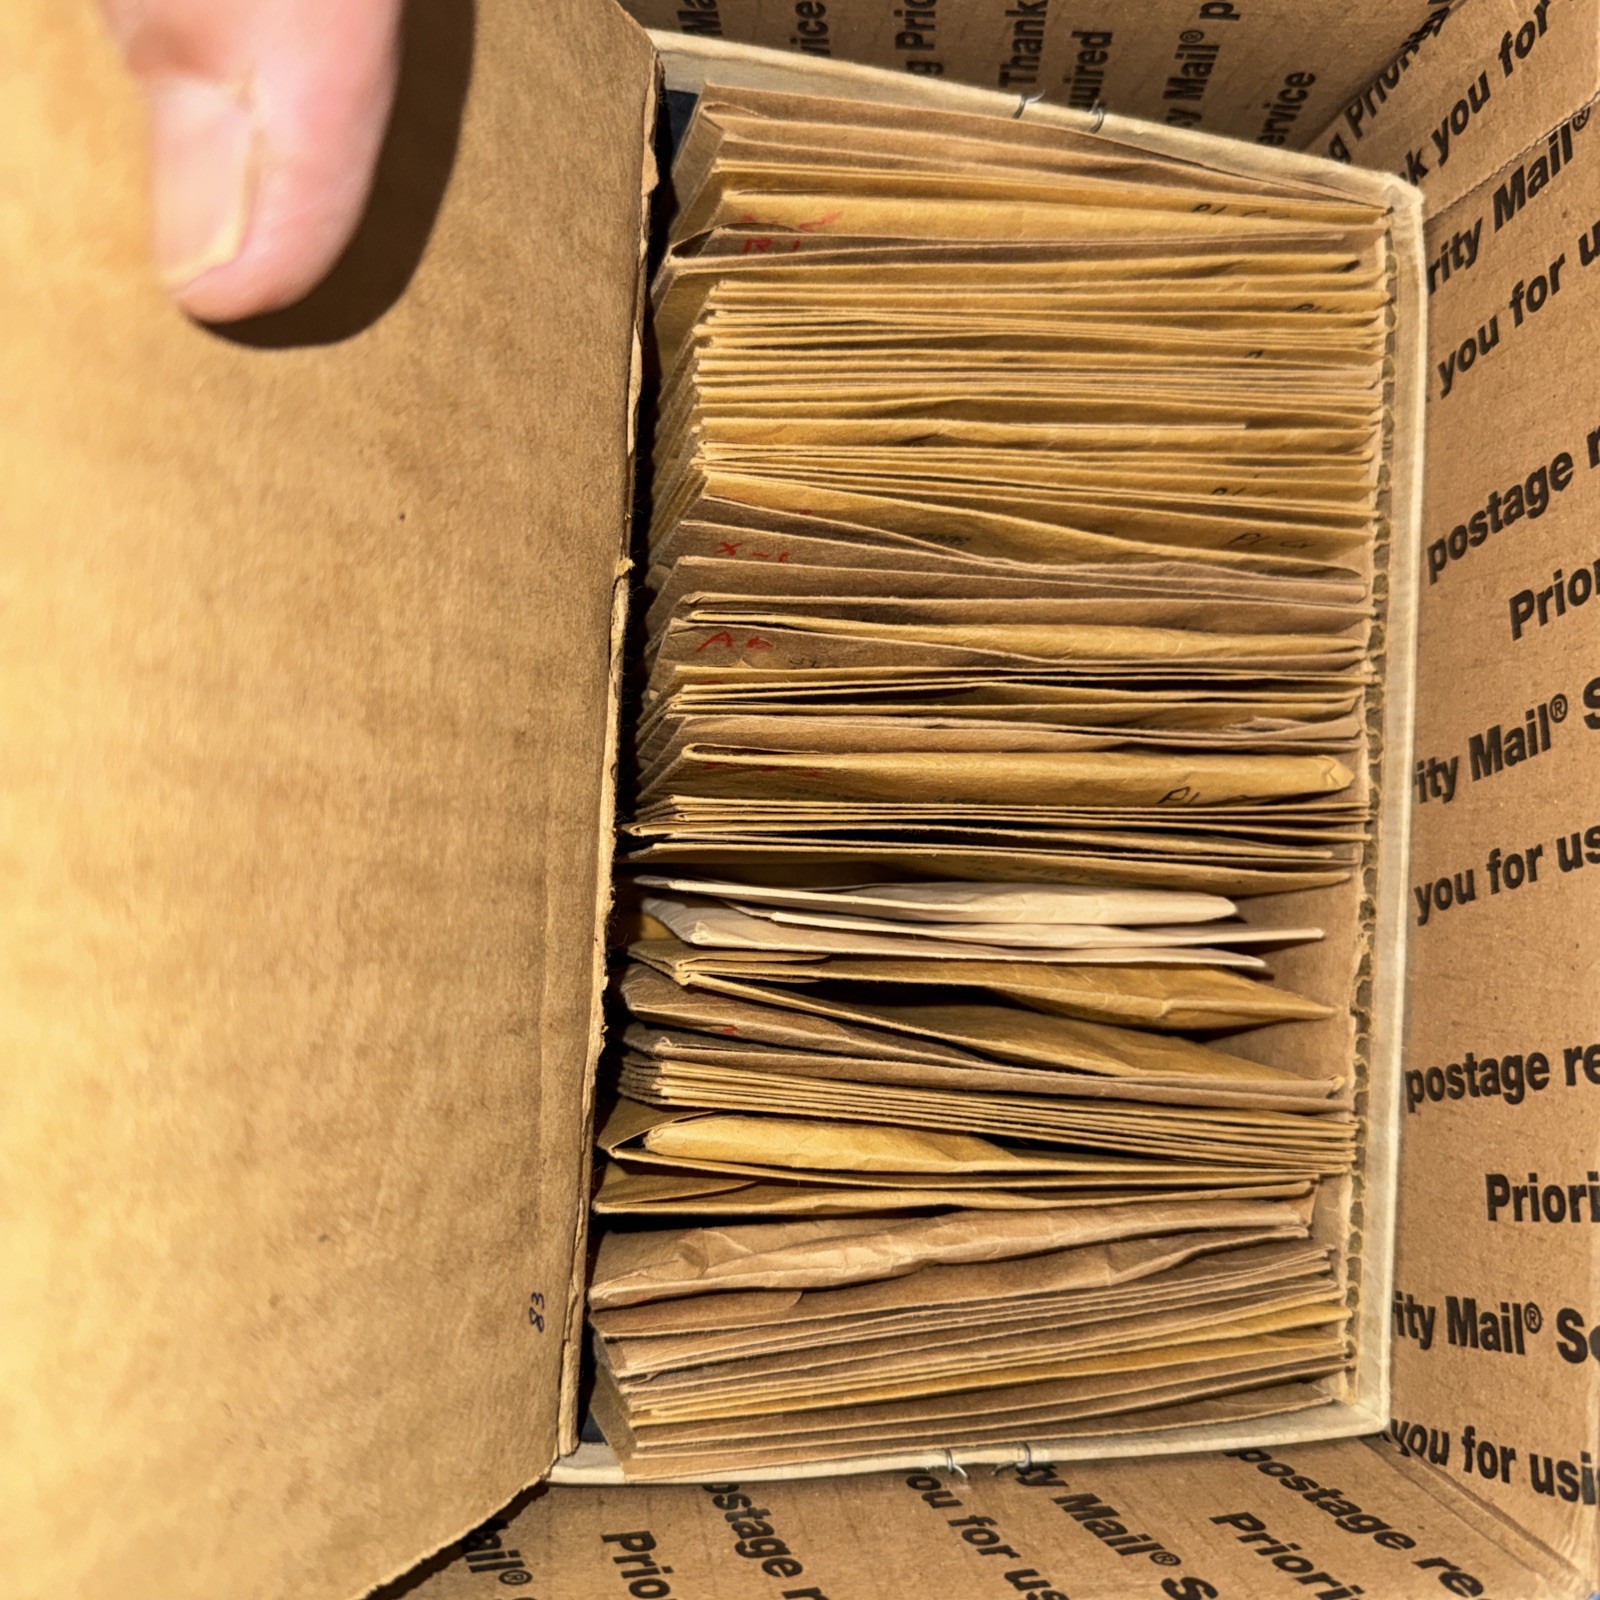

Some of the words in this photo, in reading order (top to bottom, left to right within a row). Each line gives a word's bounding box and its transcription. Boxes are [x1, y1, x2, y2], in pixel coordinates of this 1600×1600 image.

[790, 1, 831, 56] ice
[999, 0, 1047, 88] Thank
[1430, 71, 1491, 168] you
[1436, 314, 1500, 400] you
[1509, 252, 1566, 329] for
[1426, 452, 1574, 587] postage
[1413, 754, 1460, 805] ity
[1413, 868, 1477, 927] you
[1485, 843, 1544, 896] for
[1404, 1051, 1551, 1114] postage
[528, 1291, 545, 1334] 83
[1392, 1290, 1436, 1351] ity
[1390, 1417, 1451, 1467] you
[1460, 1424, 1518, 1485] for
[1222, 1447, 1417, 1550] postage
[947, 1514, 1022, 1559] for
